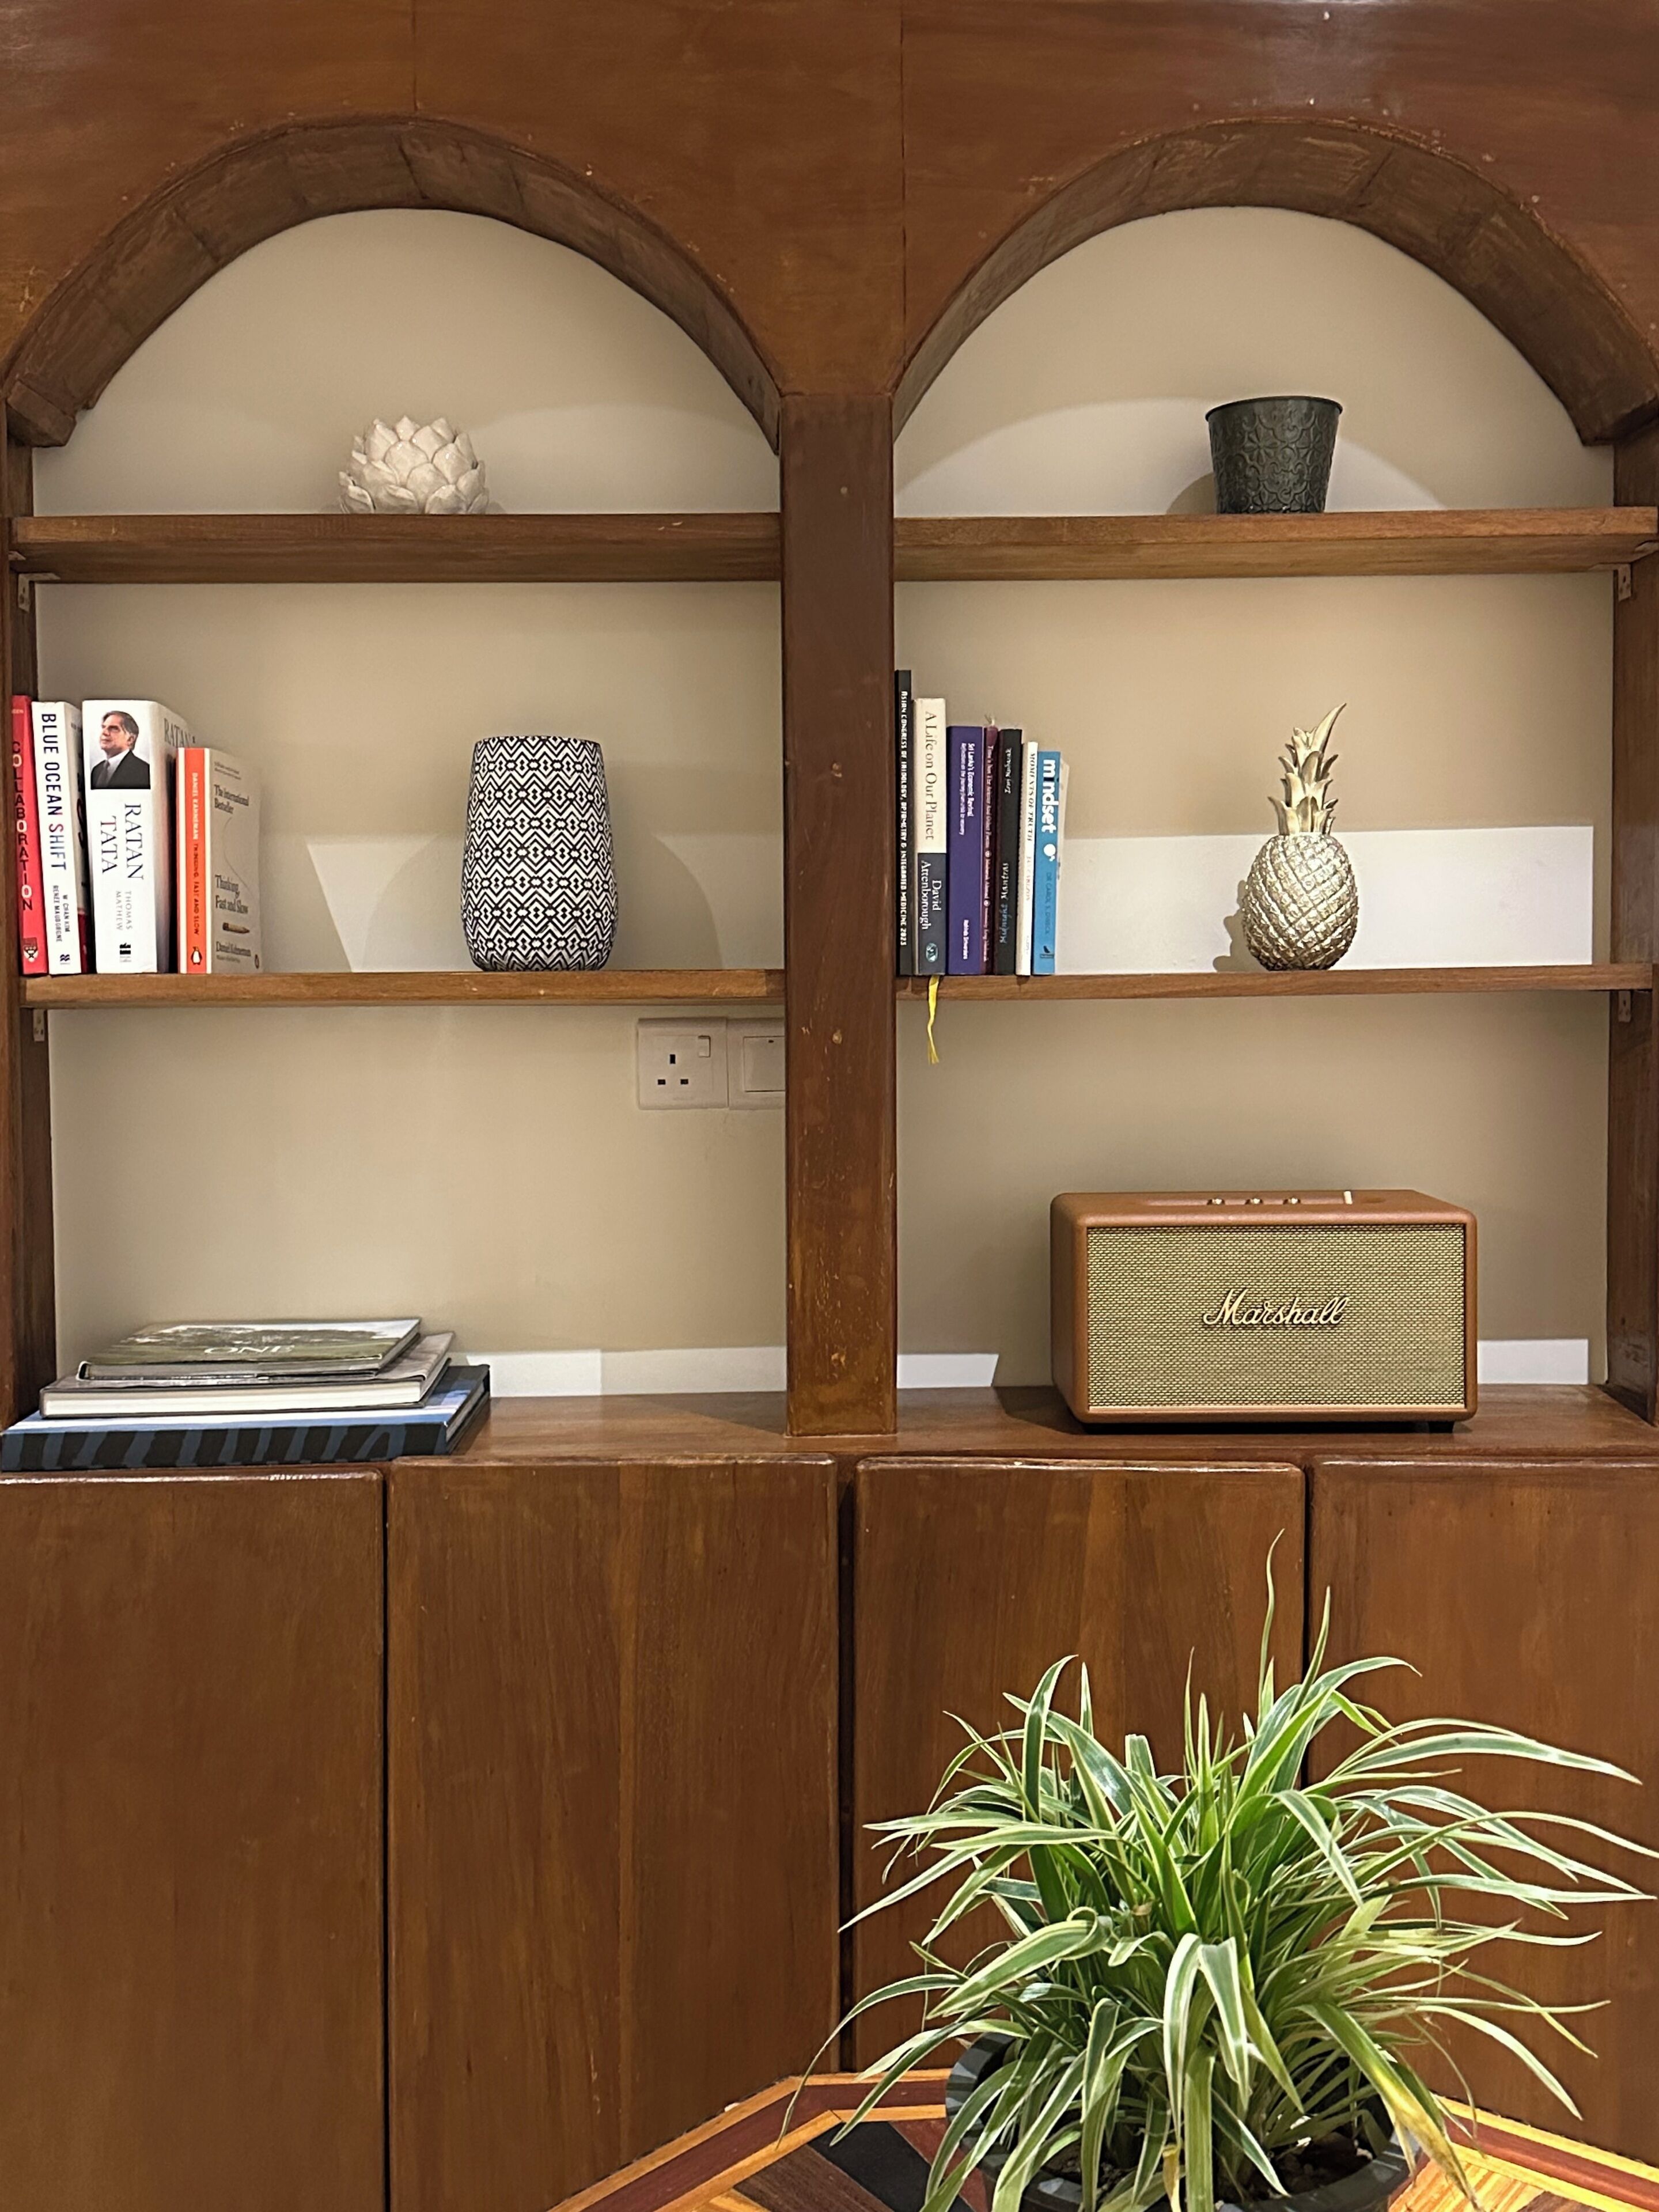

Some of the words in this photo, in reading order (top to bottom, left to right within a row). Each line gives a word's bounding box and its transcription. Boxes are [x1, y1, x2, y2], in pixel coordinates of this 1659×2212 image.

[41, 713, 59, 754] BLUE
[164, 718, 191, 748] RATAN
[925, 711, 937, 721] A
[925, 725, 937, 751] Life
[925, 753, 934, 768] on
[1028, 753, 1036, 796] MOMENTS
[44, 762, 63, 815] OCEAN
[925, 772, 938, 798] Our
[1028, 798, 1035, 808] OF
[1041, 759, 1060, 834] mindset
[12, 741, 33, 911] COLLABORATION
[925, 801, 938, 840] Planet
[48, 823, 67, 870] SHIFT
[100, 815, 118, 874] TATA
[124, 803, 144, 880] RATAN
[919, 860, 931, 930] Attenborough
[931, 880, 942, 911] David
[1000, 862, 1009, 900] Mantras
[115, 890, 124, 930] MATHEW
[124, 890, 133, 930] THOMAS
[215, 895, 227, 910] Fast
[227, 899, 236, 912] and
[236, 900, 249, 914] Slow
[999, 904, 1013, 944] Midnight
[1202, 1288, 1351, 1325] Marshall
